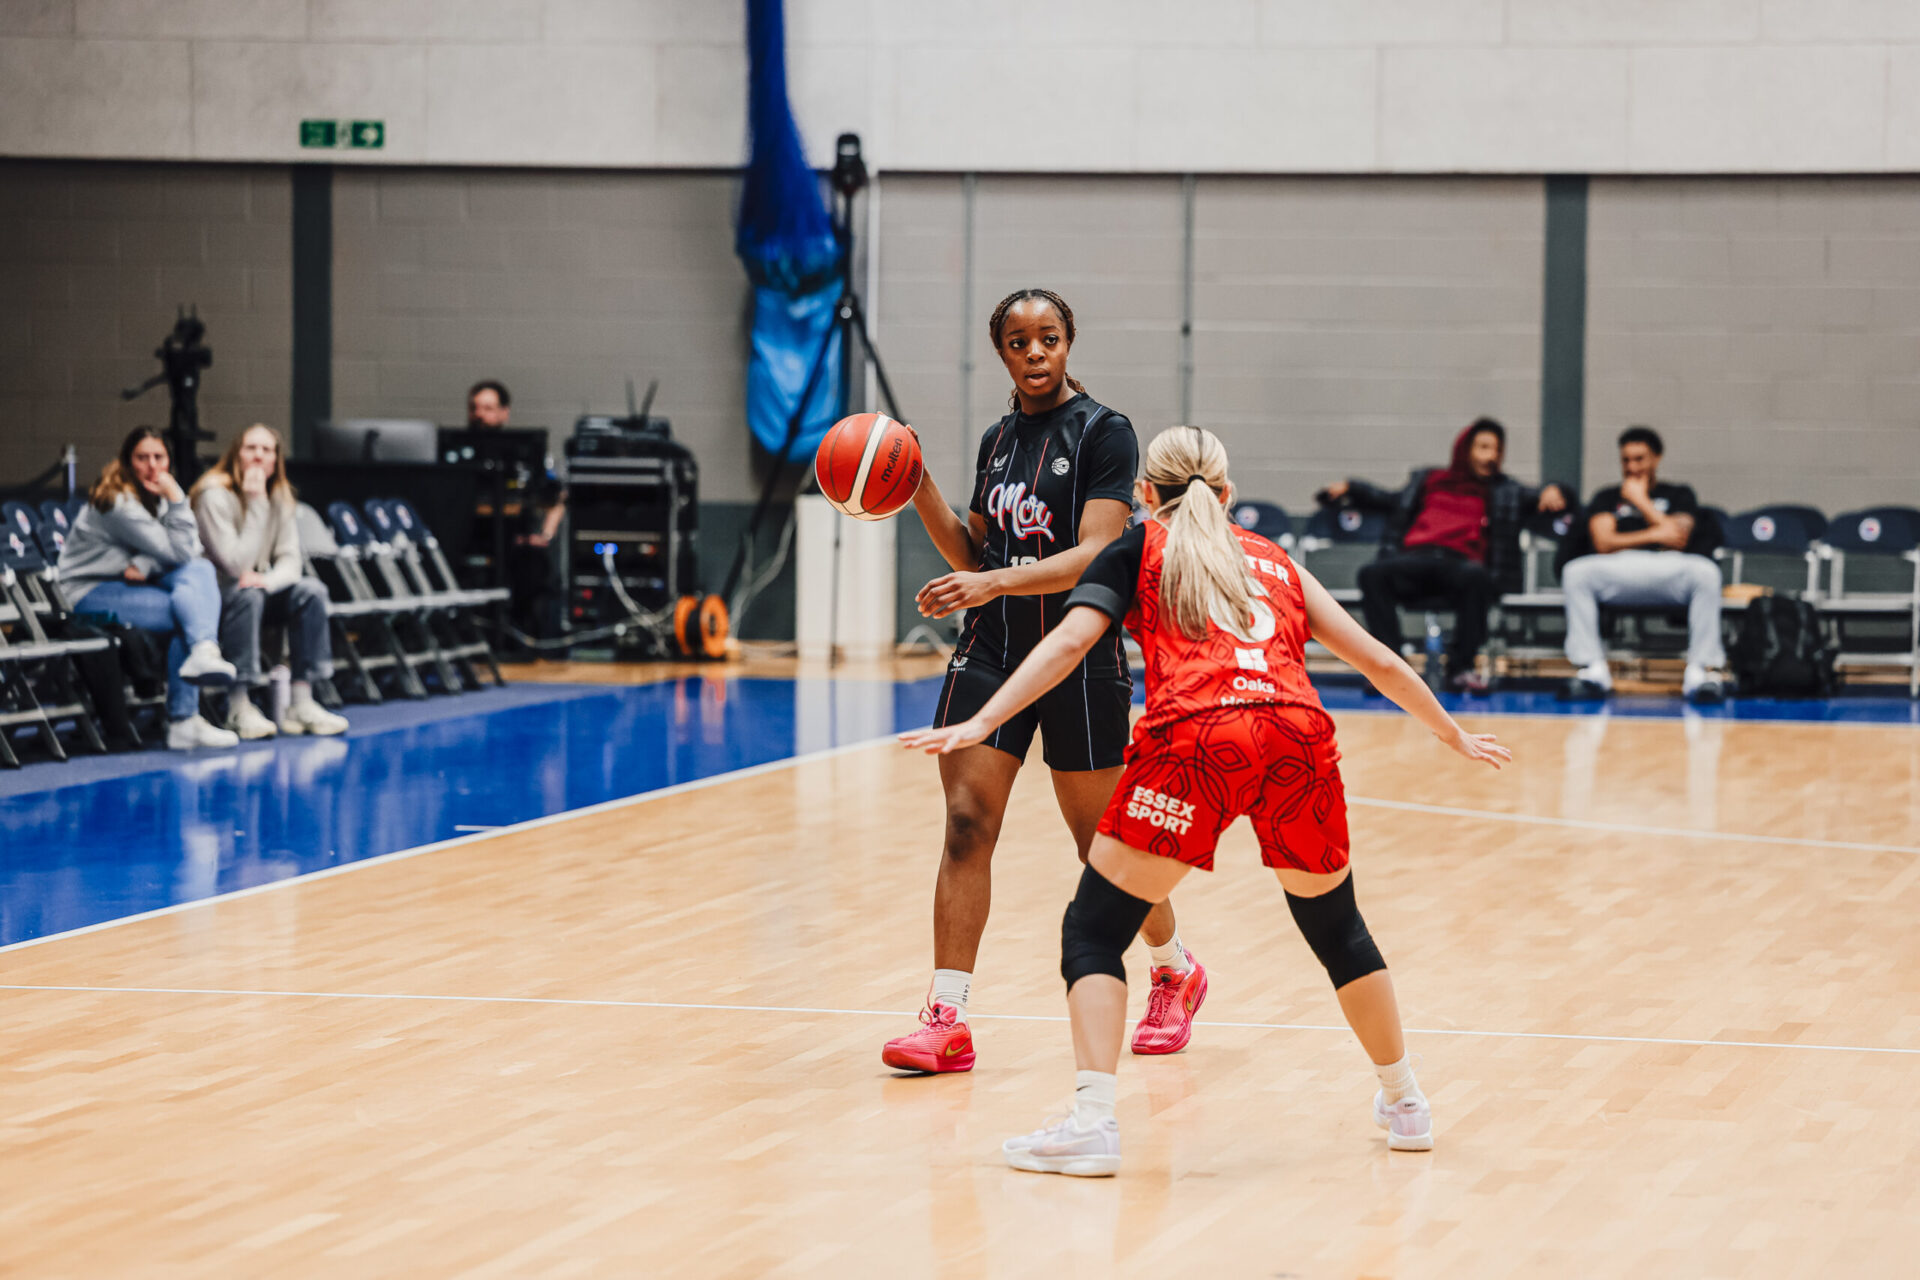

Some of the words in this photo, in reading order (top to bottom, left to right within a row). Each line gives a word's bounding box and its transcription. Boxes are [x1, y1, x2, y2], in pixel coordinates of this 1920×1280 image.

[881, 438, 903, 483] molten
[1233, 676, 1276, 694] Oaks
[1126, 801, 1192, 836] SPORT
[1132, 785, 1196, 821] ESSEX
